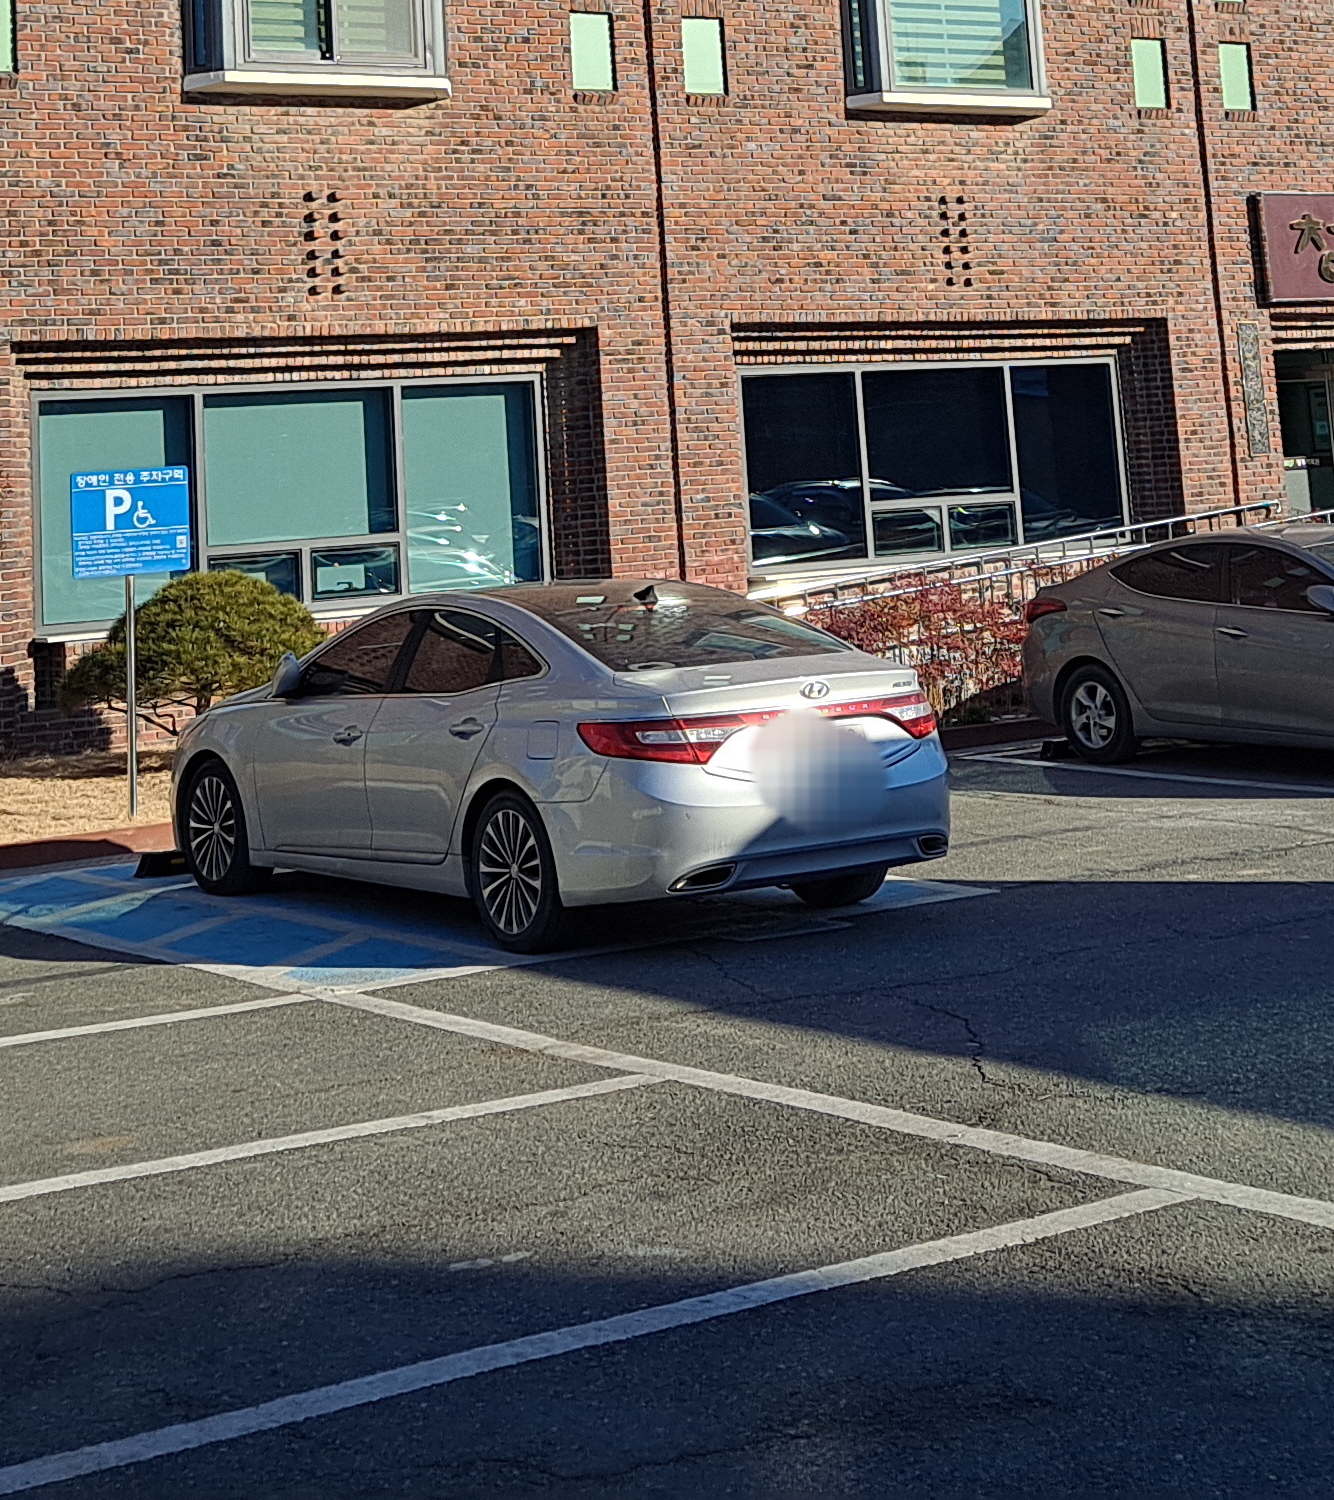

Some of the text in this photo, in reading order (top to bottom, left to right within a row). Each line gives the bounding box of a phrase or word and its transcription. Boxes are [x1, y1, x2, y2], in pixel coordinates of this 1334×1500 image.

[76, 474, 109, 487] 장애인
[114, 471, 135, 484] 전용
[105, 488, 132, 531] P
